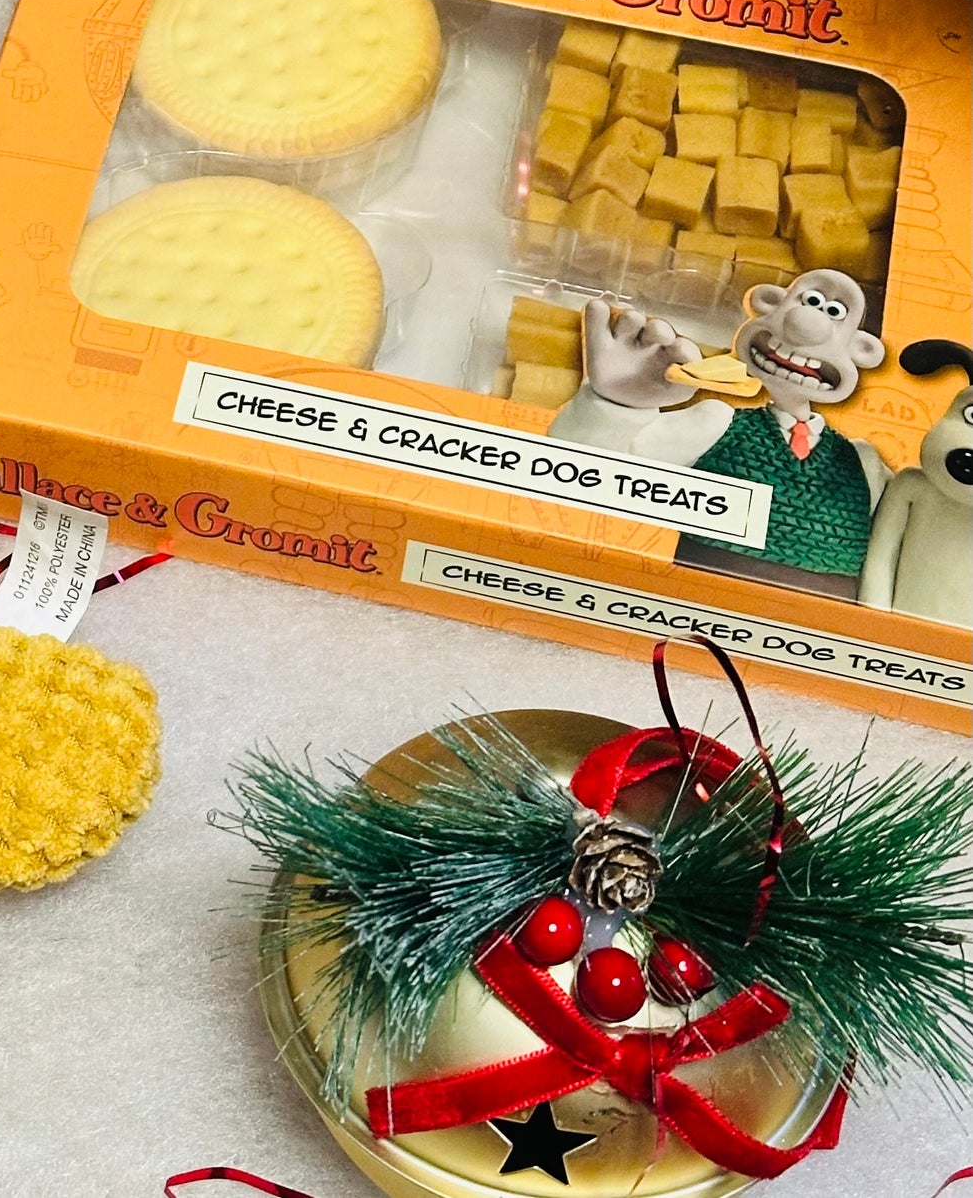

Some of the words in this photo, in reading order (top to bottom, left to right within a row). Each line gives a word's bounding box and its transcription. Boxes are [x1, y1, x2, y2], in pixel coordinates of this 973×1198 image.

[216, 390, 338, 432] CHEESE
[348, 418, 368, 441] &
[378, 425, 521, 471] CRACKER
[530, 458, 602, 488] DOG
[614, 475, 729, 516] TREATS
[35, 578, 58, 609] 100%
[49, 513, 73, 575] POLYESTER
[74, 562, 88, 578] IN
[77, 524, 97, 562] CHINA
[124, 493, 168, 528] &
[174, 491, 379, 574] Gromit
[55, 578, 84, 622] MADE
[442, 565, 565, 602] CHEESE
[575, 593, 596, 611] &
[606, 601, 754, 643] CRACKER
[762, 636, 836, 661] DOG
[848, 653, 967, 691] TREATS
